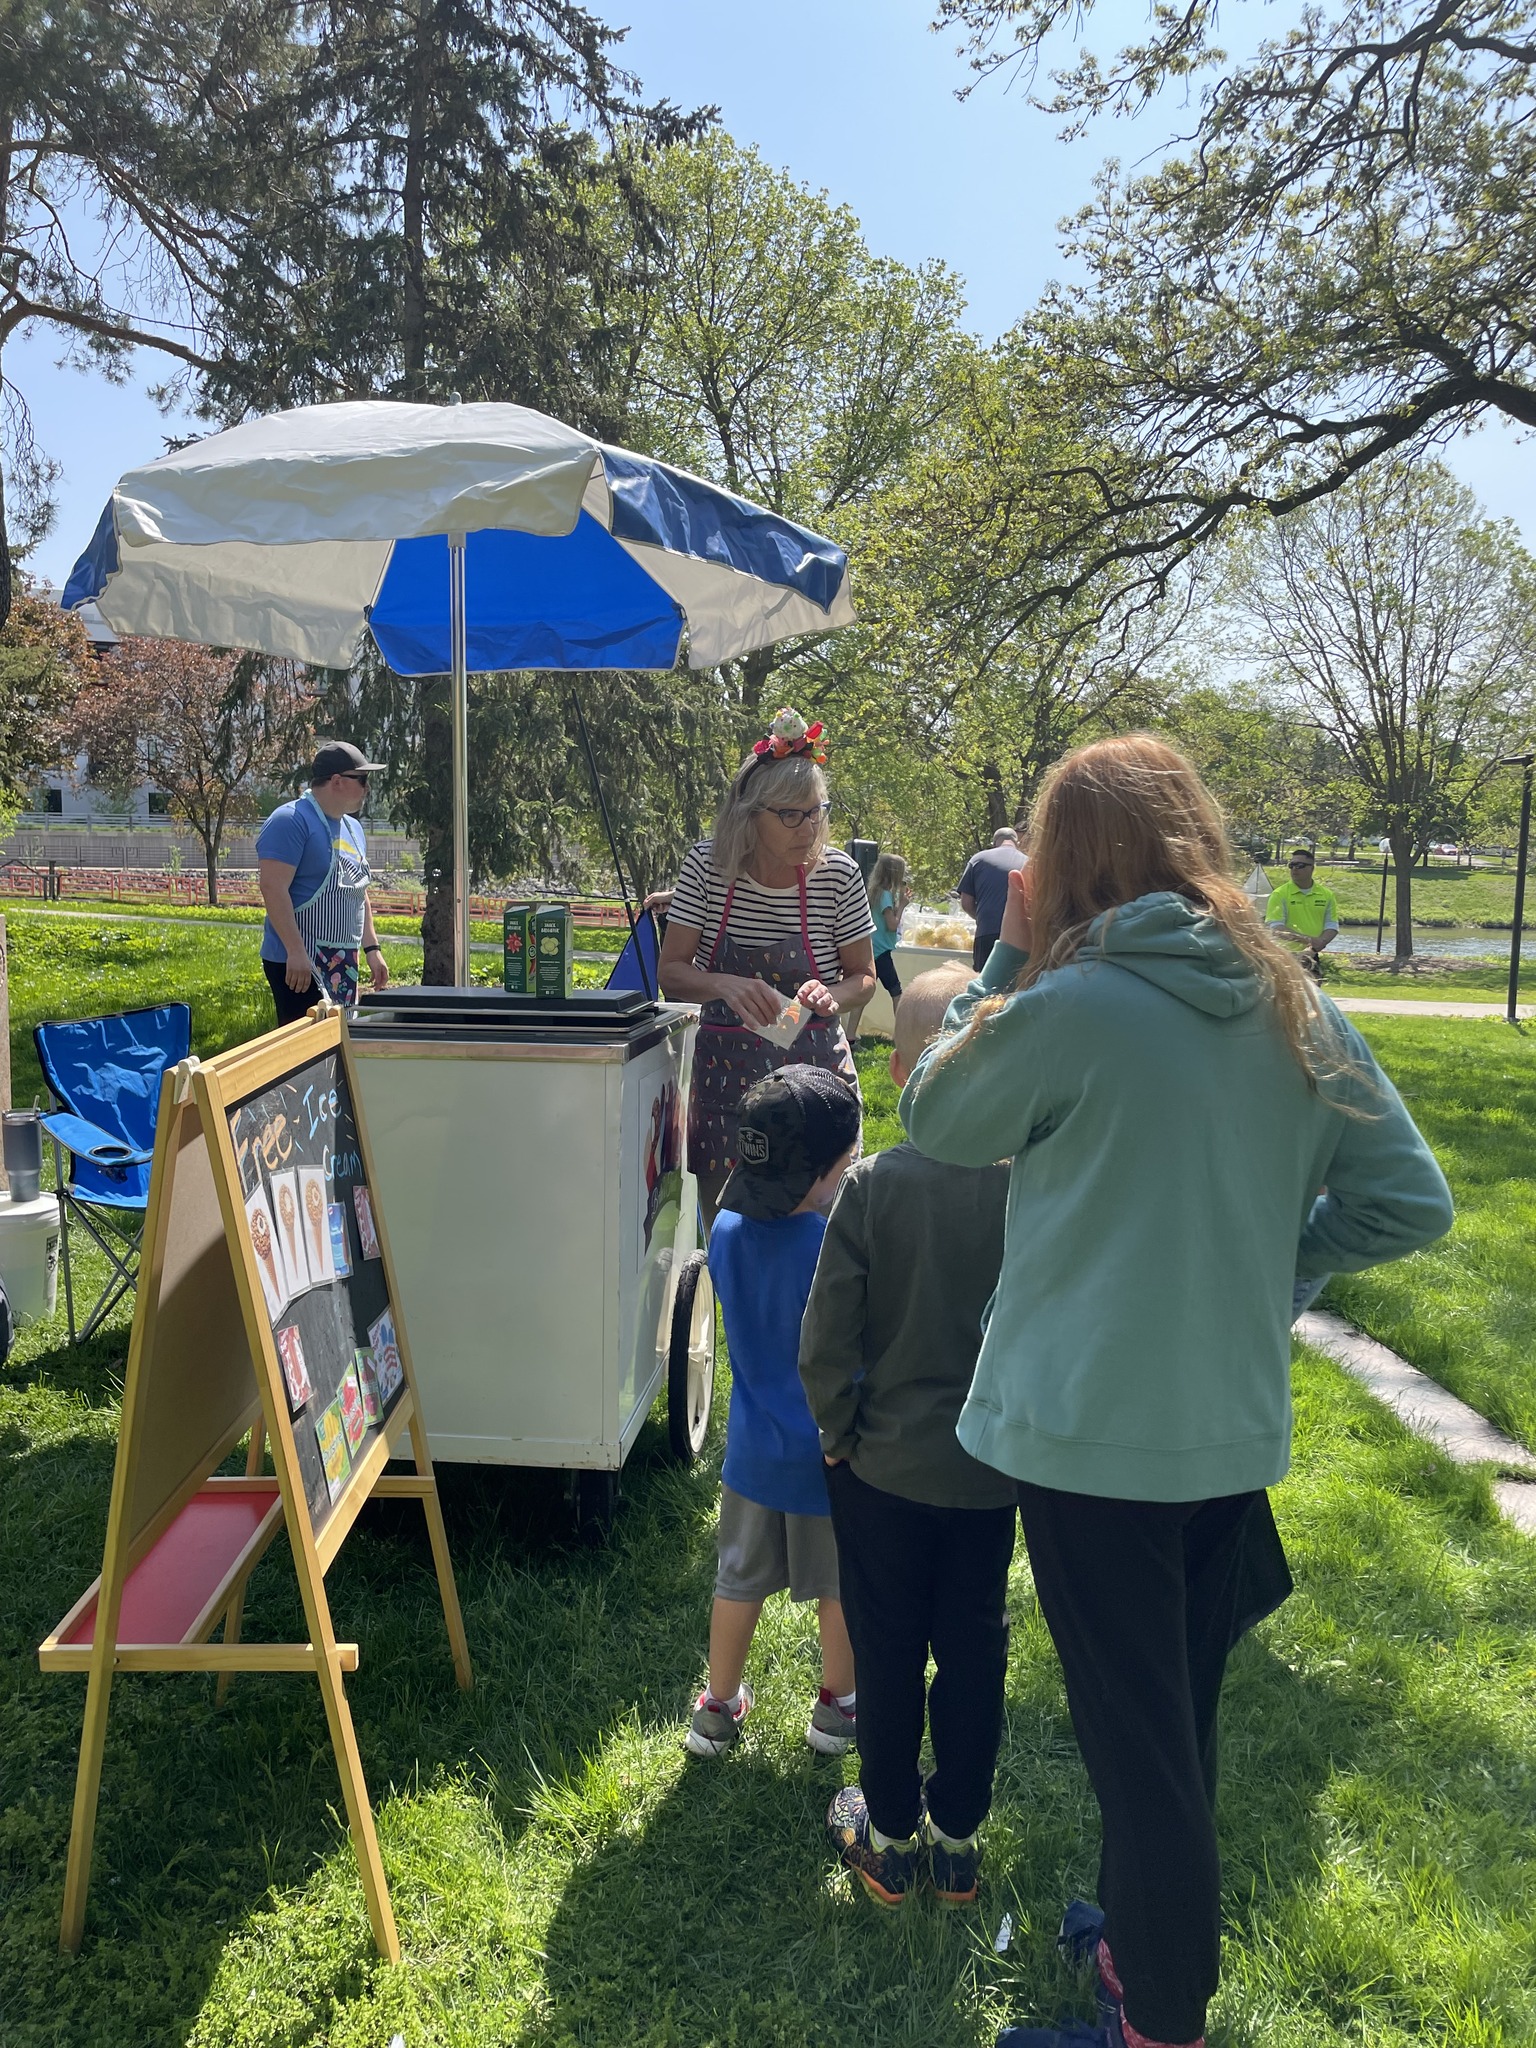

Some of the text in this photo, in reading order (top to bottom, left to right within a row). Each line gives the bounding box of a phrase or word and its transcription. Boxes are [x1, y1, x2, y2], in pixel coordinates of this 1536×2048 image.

[229, 1084, 342, 1195] Free Ice
[322, 1144, 364, 1182] Cream
